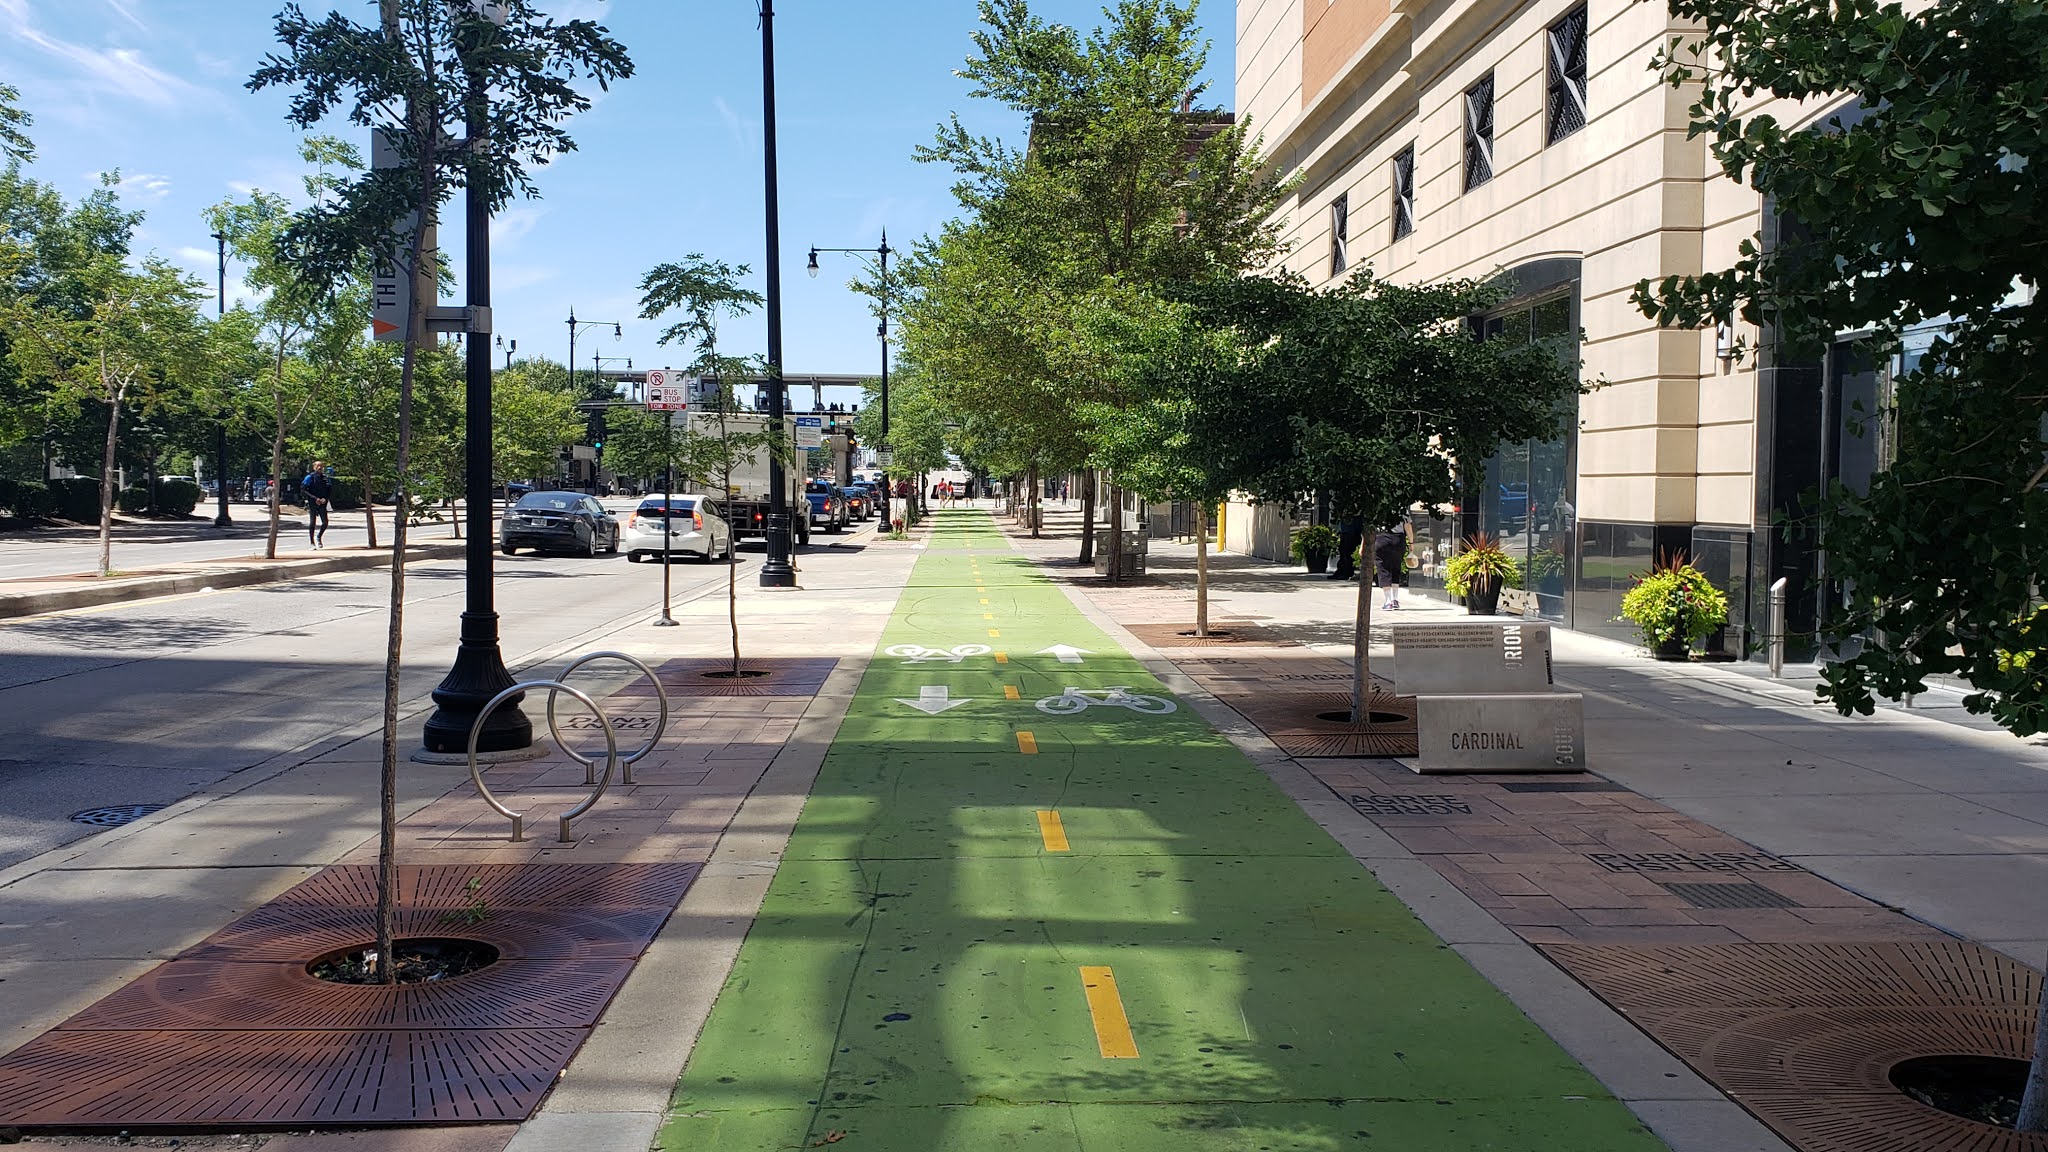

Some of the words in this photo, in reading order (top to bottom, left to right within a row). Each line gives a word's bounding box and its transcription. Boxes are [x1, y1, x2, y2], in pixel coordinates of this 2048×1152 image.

[1451, 732, 1524, 750] CARDINAL
[1351, 794, 1465, 804] AGREE
[1355, 804, 1473, 815] AGREE
[1589, 852, 1778, 862] PUBLISH
[1603, 861, 1799, 871] PUBLISH
